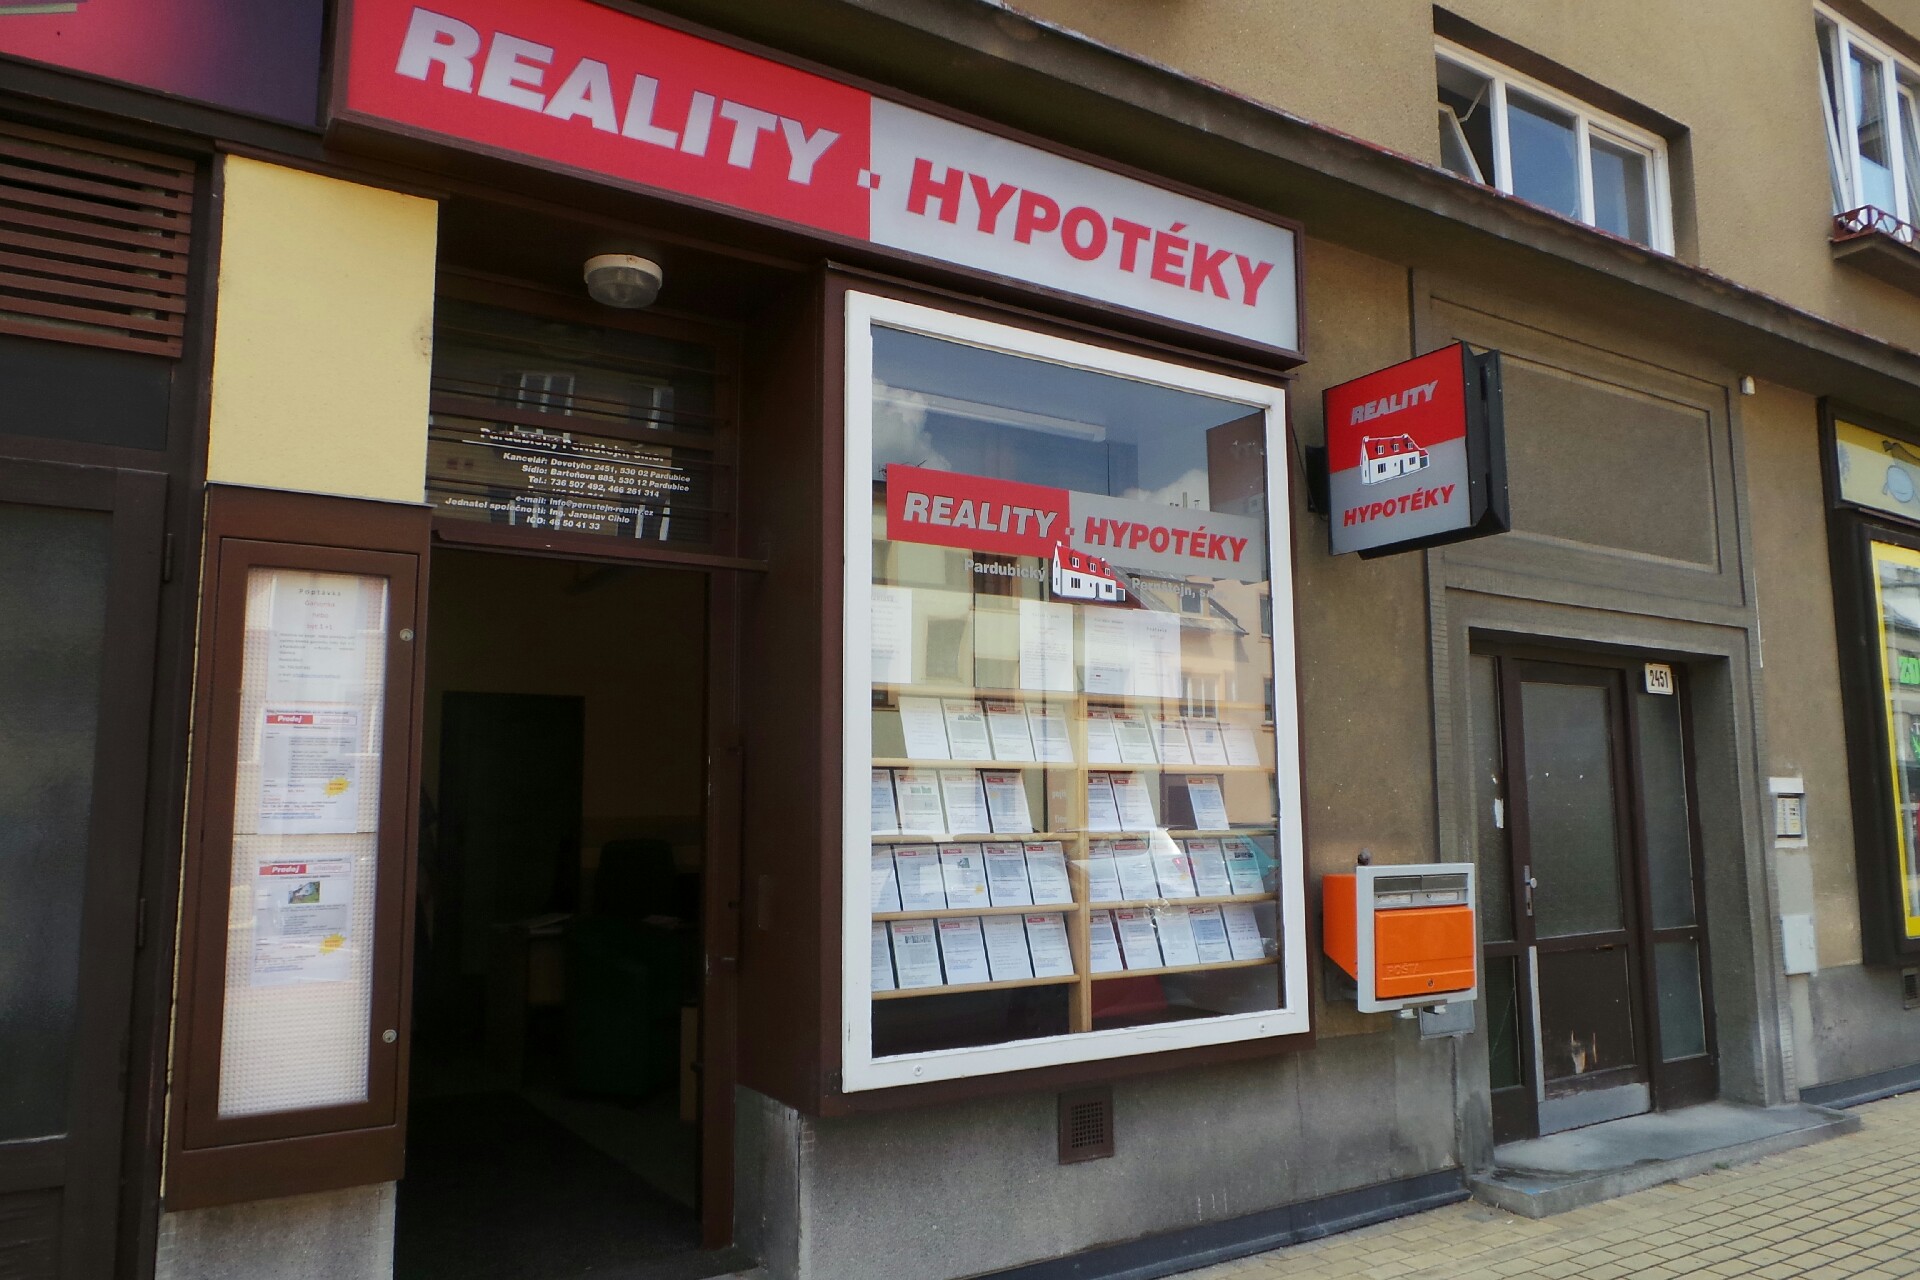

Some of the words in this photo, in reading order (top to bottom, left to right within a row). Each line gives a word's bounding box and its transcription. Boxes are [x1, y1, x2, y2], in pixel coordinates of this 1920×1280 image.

[395, 6, 840, 185] REALITY
[906, 157, 1275, 307] HYPOTÉKY
[1350, 380, 1439, 425] REALITY
[503, 452, 548, 465] Kancelář:
[593, 464, 618, 474] 2451,
[619, 467, 636, 476] 530
[637, 469, 649, 477] 02
[650, 471, 691, 482] Pardubice
[522, 464, 547, 475] Sídlo:
[618, 476, 635, 485] 530
[637, 479, 648, 487] 12
[648, 481, 690, 492] Pardubice
[528, 475, 547, 484] Tel.:
[568, 480, 586, 489] 507
[587, 482, 606, 493] 492,
[643, 489, 660, 498] 314
[445, 497, 488, 509] Jednatel
[489, 502, 547, 515] společnosti:
[549, 507, 566, 518] Ing.
[568, 510, 606, 521] Jaroslav
[515, 495, 547, 505] e-mail:
[1343, 484, 1456, 527] HYPOTÉKY
[562, 519, 574, 528] 50
[575, 521, 586, 529] 41
[588, 522, 600, 530] 33
[903, 491, 1058, 538] REALITY
[1084, 516, 1248, 562] HYPOTÉKY
[964, 559, 1046, 582] Pardubický
[1131, 577, 1196, 601] Pernštejn,
[1649, 669, 1669, 689] 2451
[277, 715, 303, 724] Prodej
[271, 865, 299, 874] Prodej
